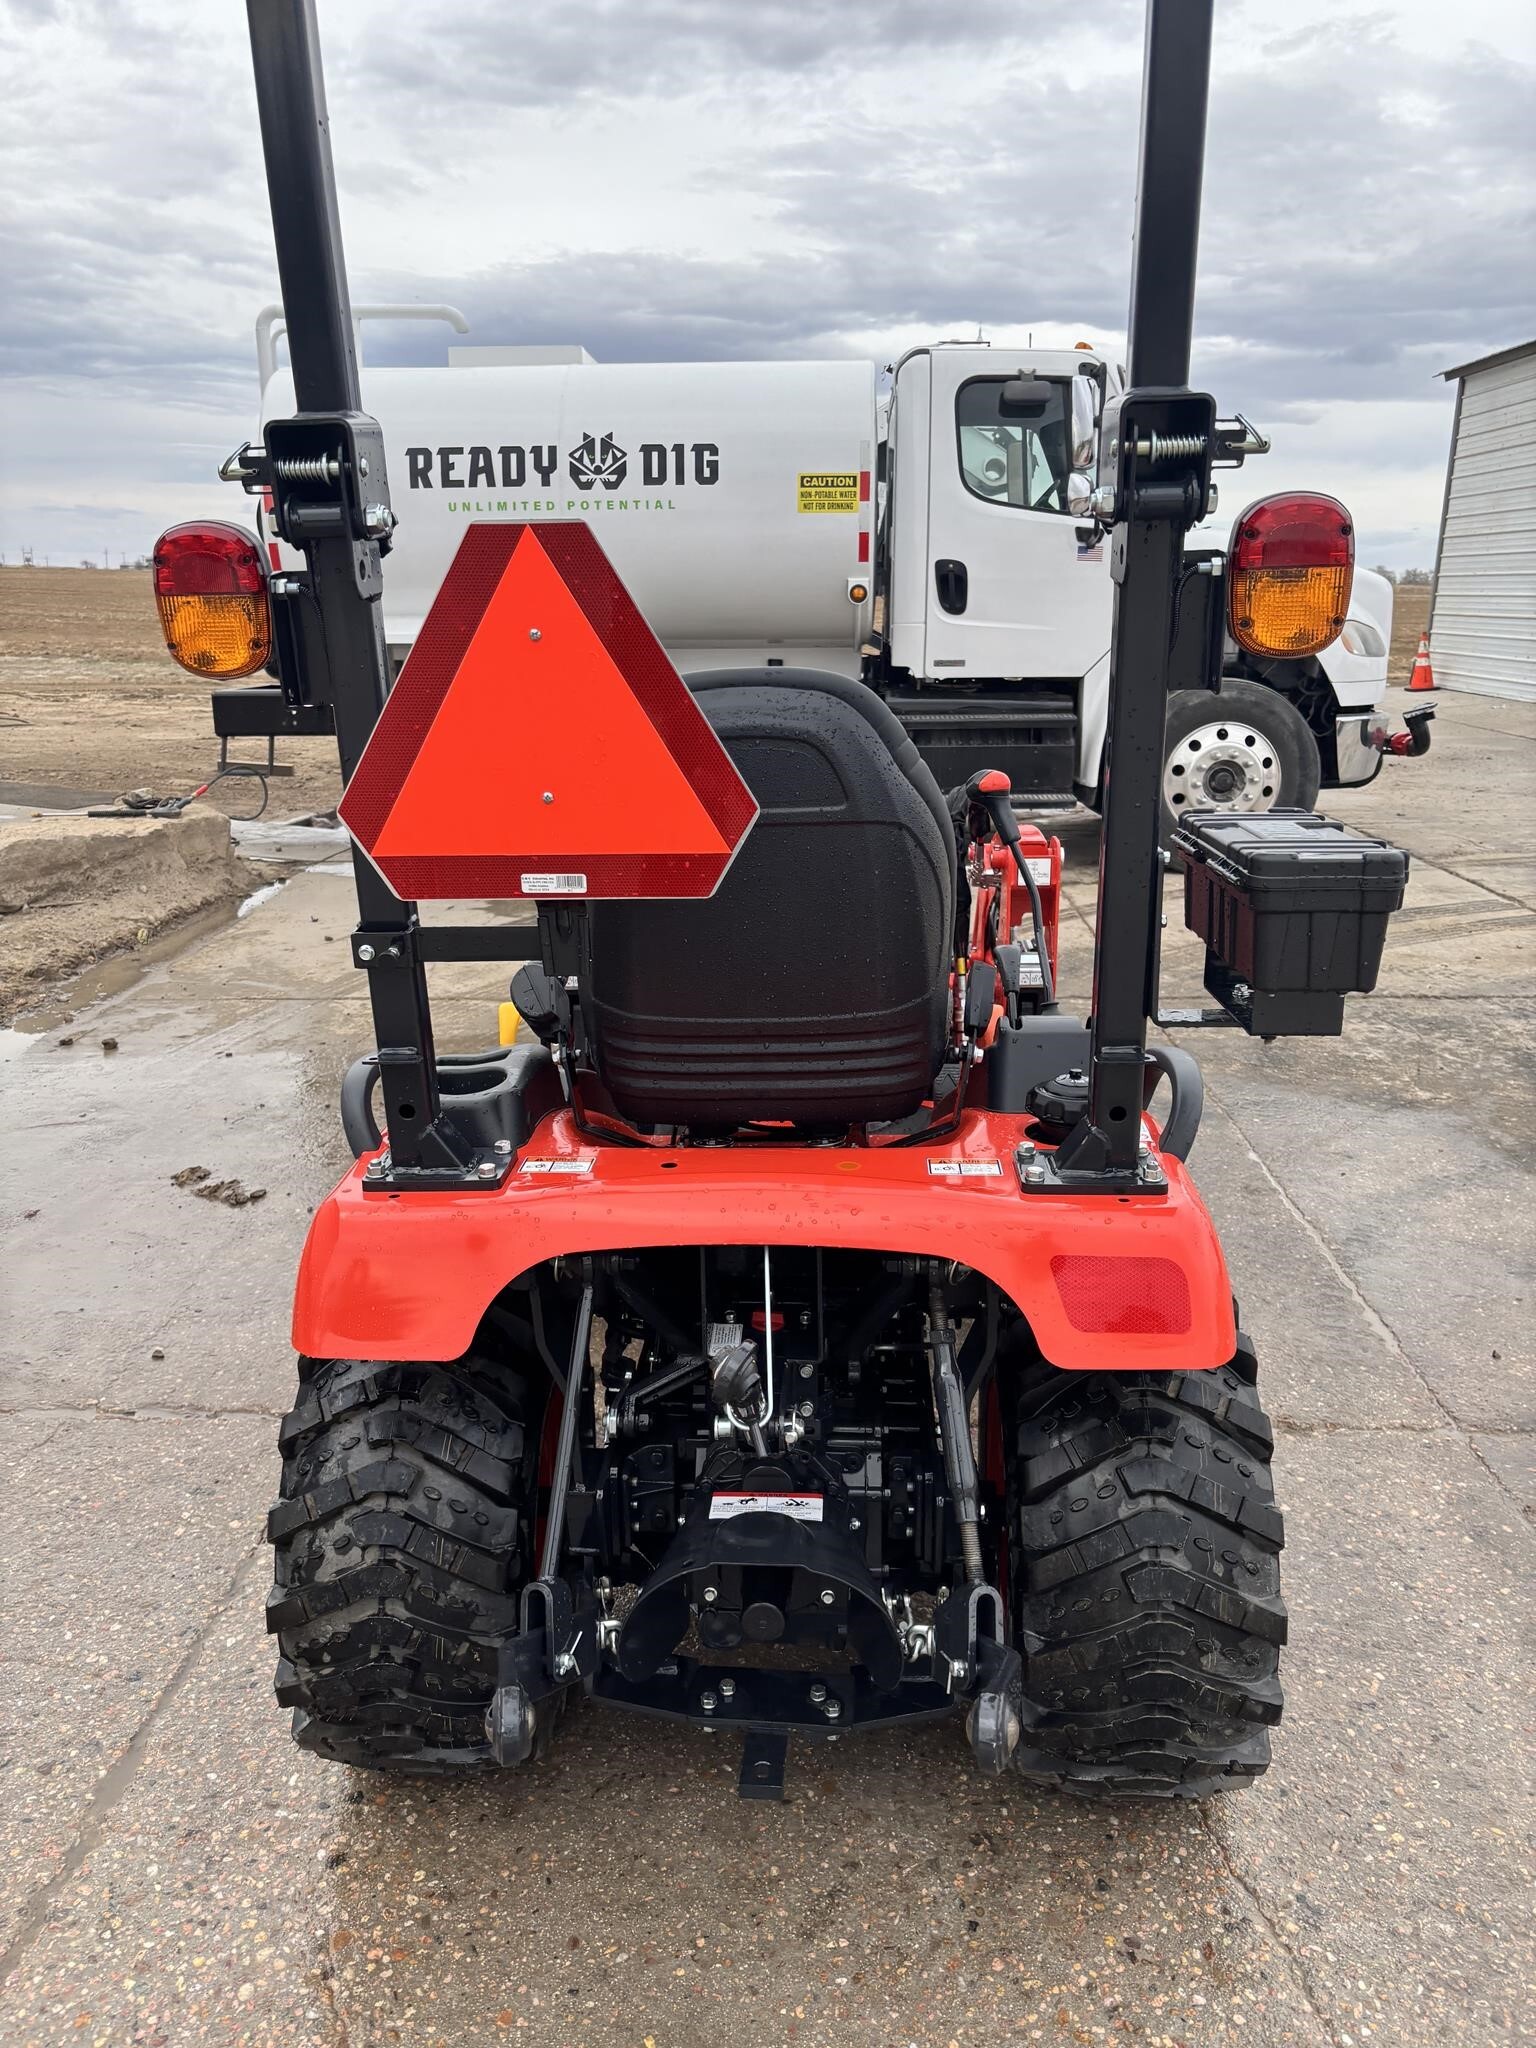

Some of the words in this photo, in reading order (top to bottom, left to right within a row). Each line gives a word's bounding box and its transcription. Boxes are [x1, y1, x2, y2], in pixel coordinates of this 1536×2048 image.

[405, 445, 557, 489] READY
[803, 477, 854, 486] CAUTION
[800, 490, 838, 498] NON-POTABLE
[839, 490, 857, 498] WATER
[448, 500, 556, 512] UNLIMITED
[567, 499, 677, 512] POTENTIAL
[803, 502, 814, 510] NOT
[815, 502, 826, 510] FOR
[827, 502, 854, 510] DRINKING
